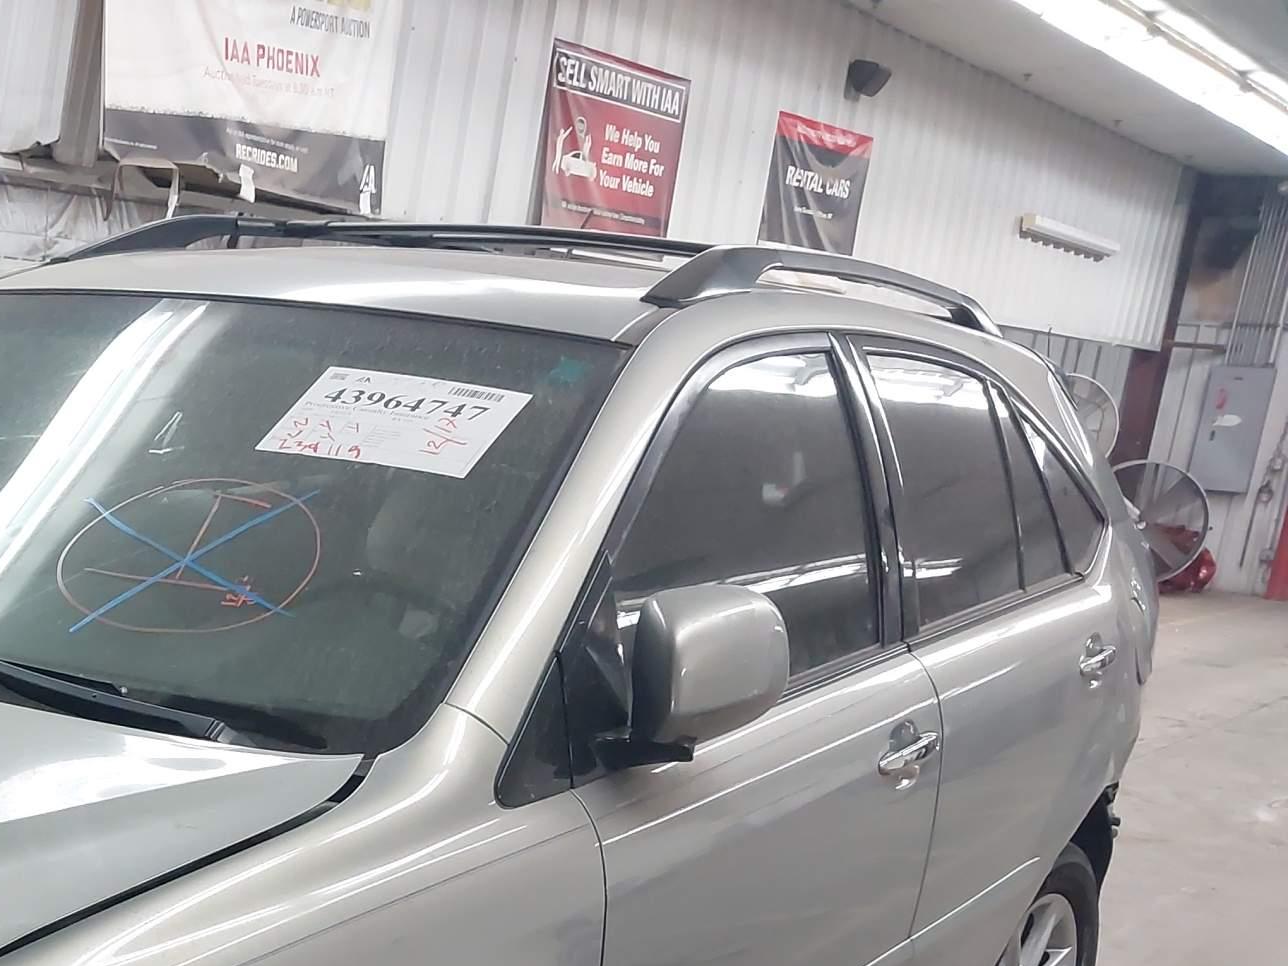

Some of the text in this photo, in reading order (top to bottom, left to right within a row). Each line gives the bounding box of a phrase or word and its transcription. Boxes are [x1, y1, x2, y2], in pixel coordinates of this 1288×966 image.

[289, 5, 297, 24] A
[297, 7, 338, 34] POWERSPORT
[340, 16, 371, 39] AUCTION
[224, 36, 321, 78] IAA PHOENIX
[557, 56, 681, 116] SELL SMART WITH IAA
[605, 124, 661, 153] We Help You
[235, 143, 298, 173] RECRIDES.COM
[601, 146, 665, 177] Earn More For
[599, 169, 654, 197] Your Vehicle
[826, 178, 851, 199] CARS
[323, 387, 491, 421] 43964747
